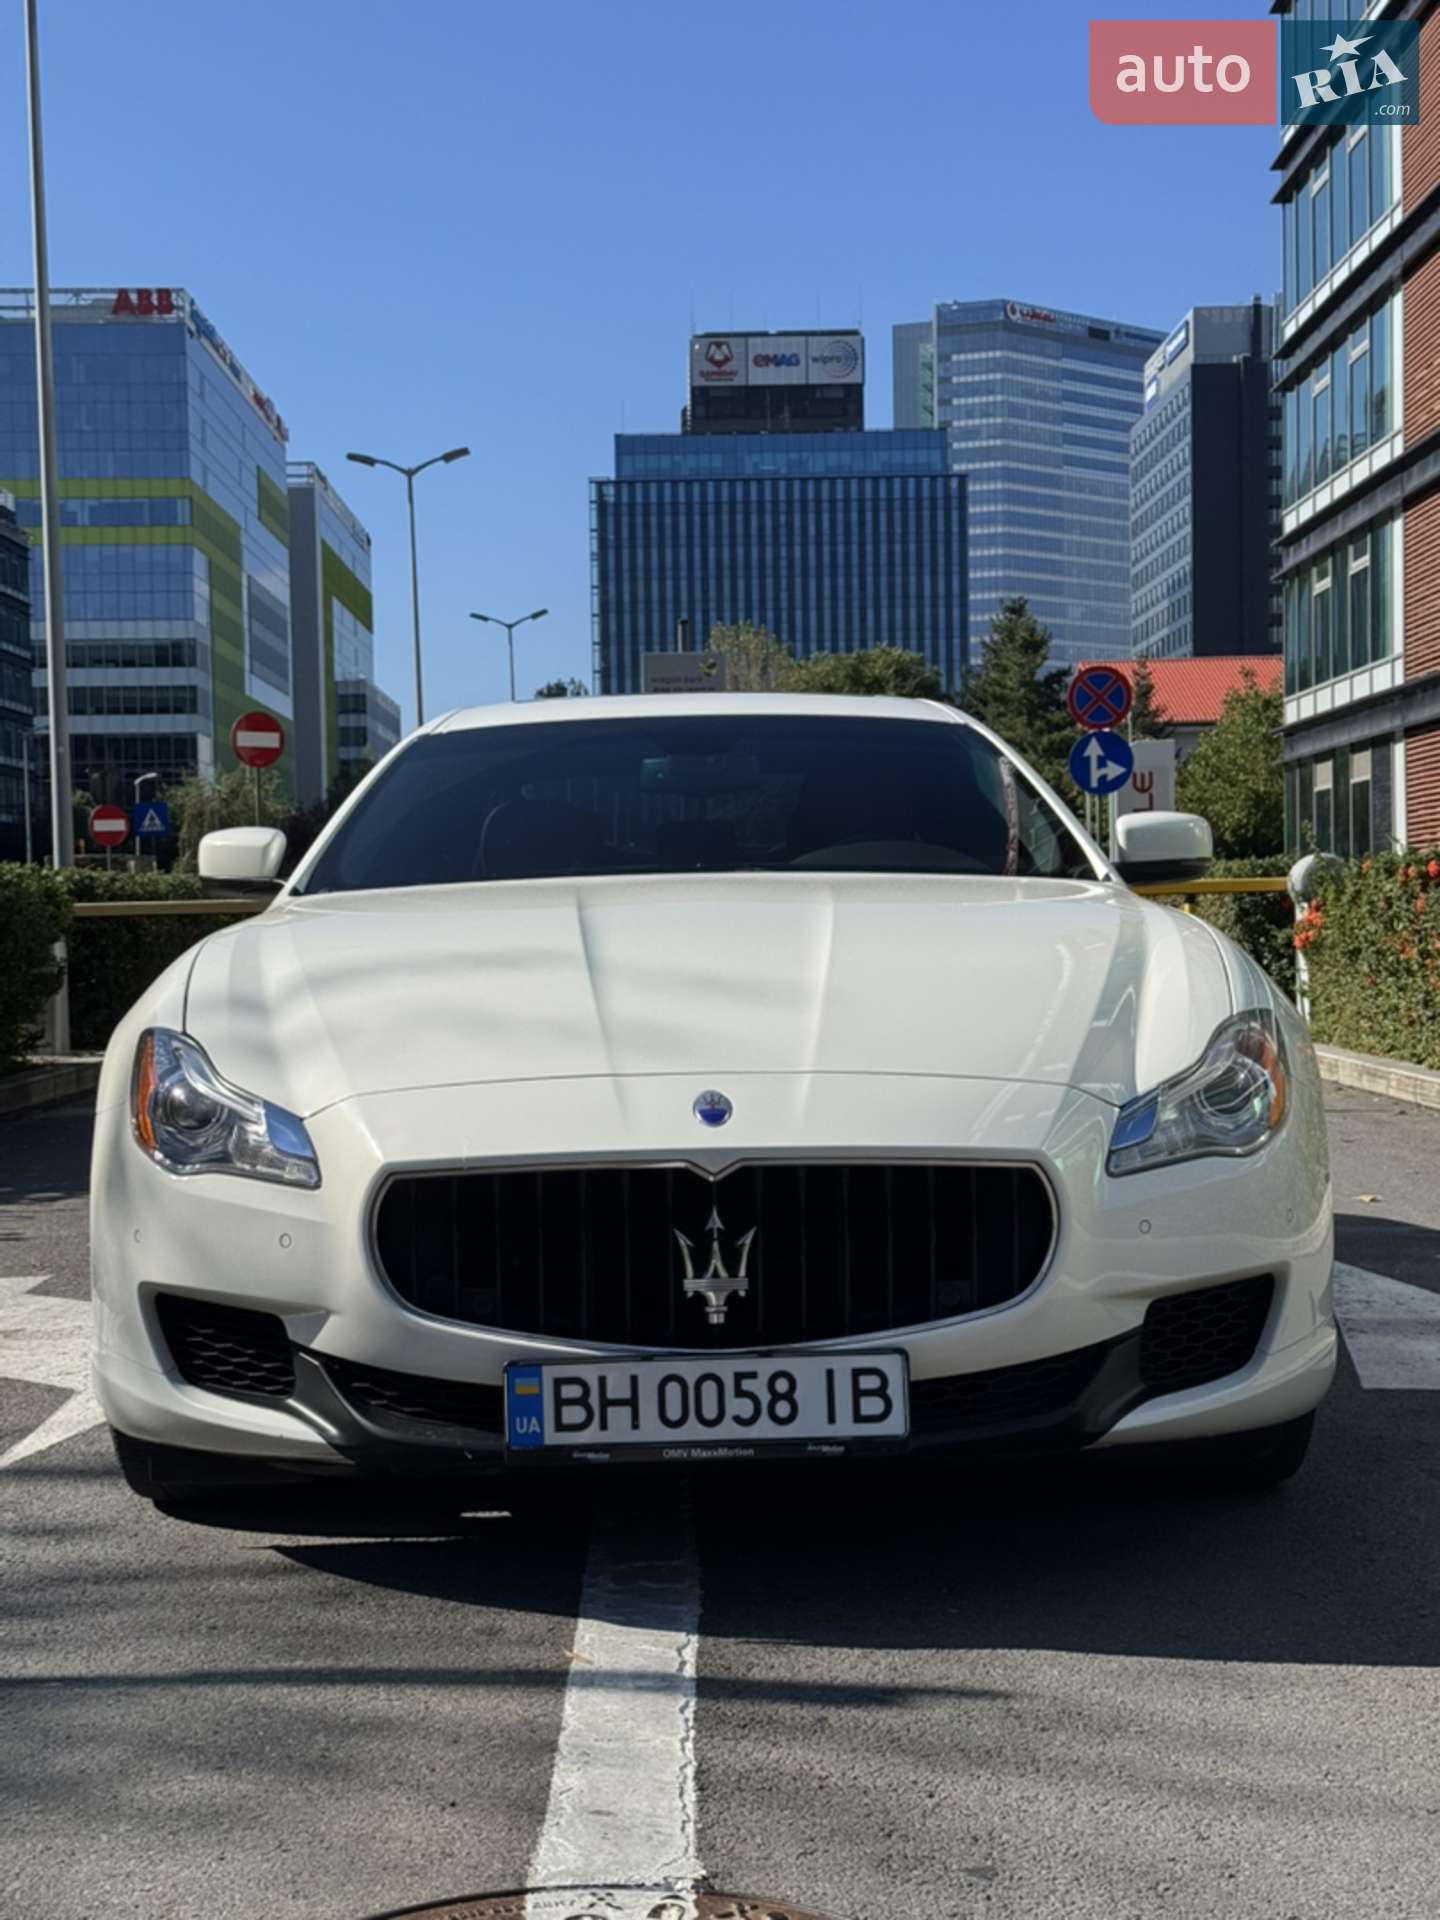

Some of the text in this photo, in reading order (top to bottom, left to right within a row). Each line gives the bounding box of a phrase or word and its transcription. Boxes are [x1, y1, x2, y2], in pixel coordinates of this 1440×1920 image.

[112, 288, 175, 315] ABB
[811, 353, 842, 366] wipro
[553, 1366, 894, 1433] BH 0058 IB
[516, 1416, 541, 1434] UA
[662, 1446, 755, 1459] OMV MaxxMotion
